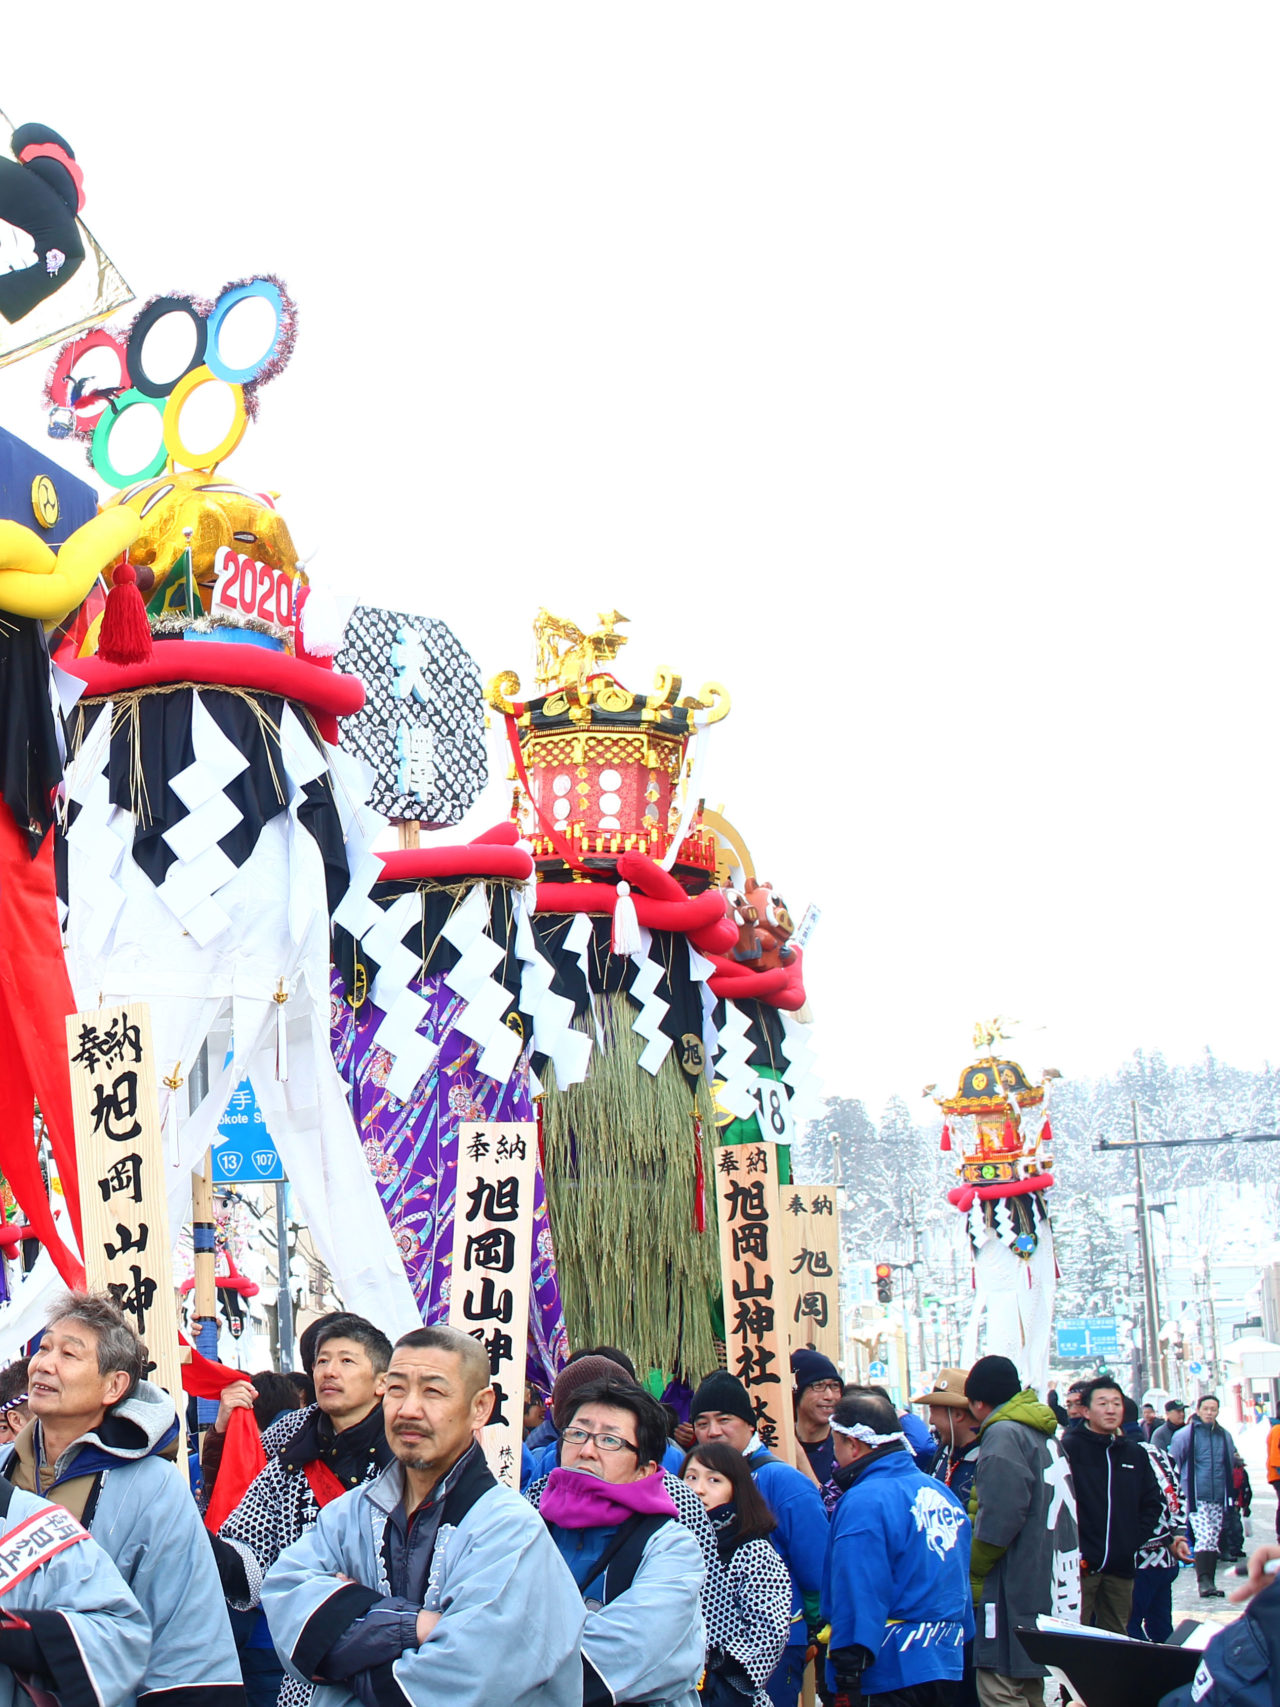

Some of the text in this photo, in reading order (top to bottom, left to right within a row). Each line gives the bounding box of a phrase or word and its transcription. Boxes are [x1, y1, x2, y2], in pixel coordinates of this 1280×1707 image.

[220, 550, 294, 627] 2020
[71, 1012, 143, 1074] 奉納
[221, 1155, 237, 1169] 13
[255, 1154, 273, 1166] 107
[466, 1132, 527, 1164] 奉納
[718, 1147, 769, 1177] 奉納
[785, 1193, 833, 1217] 奉納
[723, 1179, 782, 1389] 旭岡山神社
[789, 1247, 834, 1351] 旭岡
